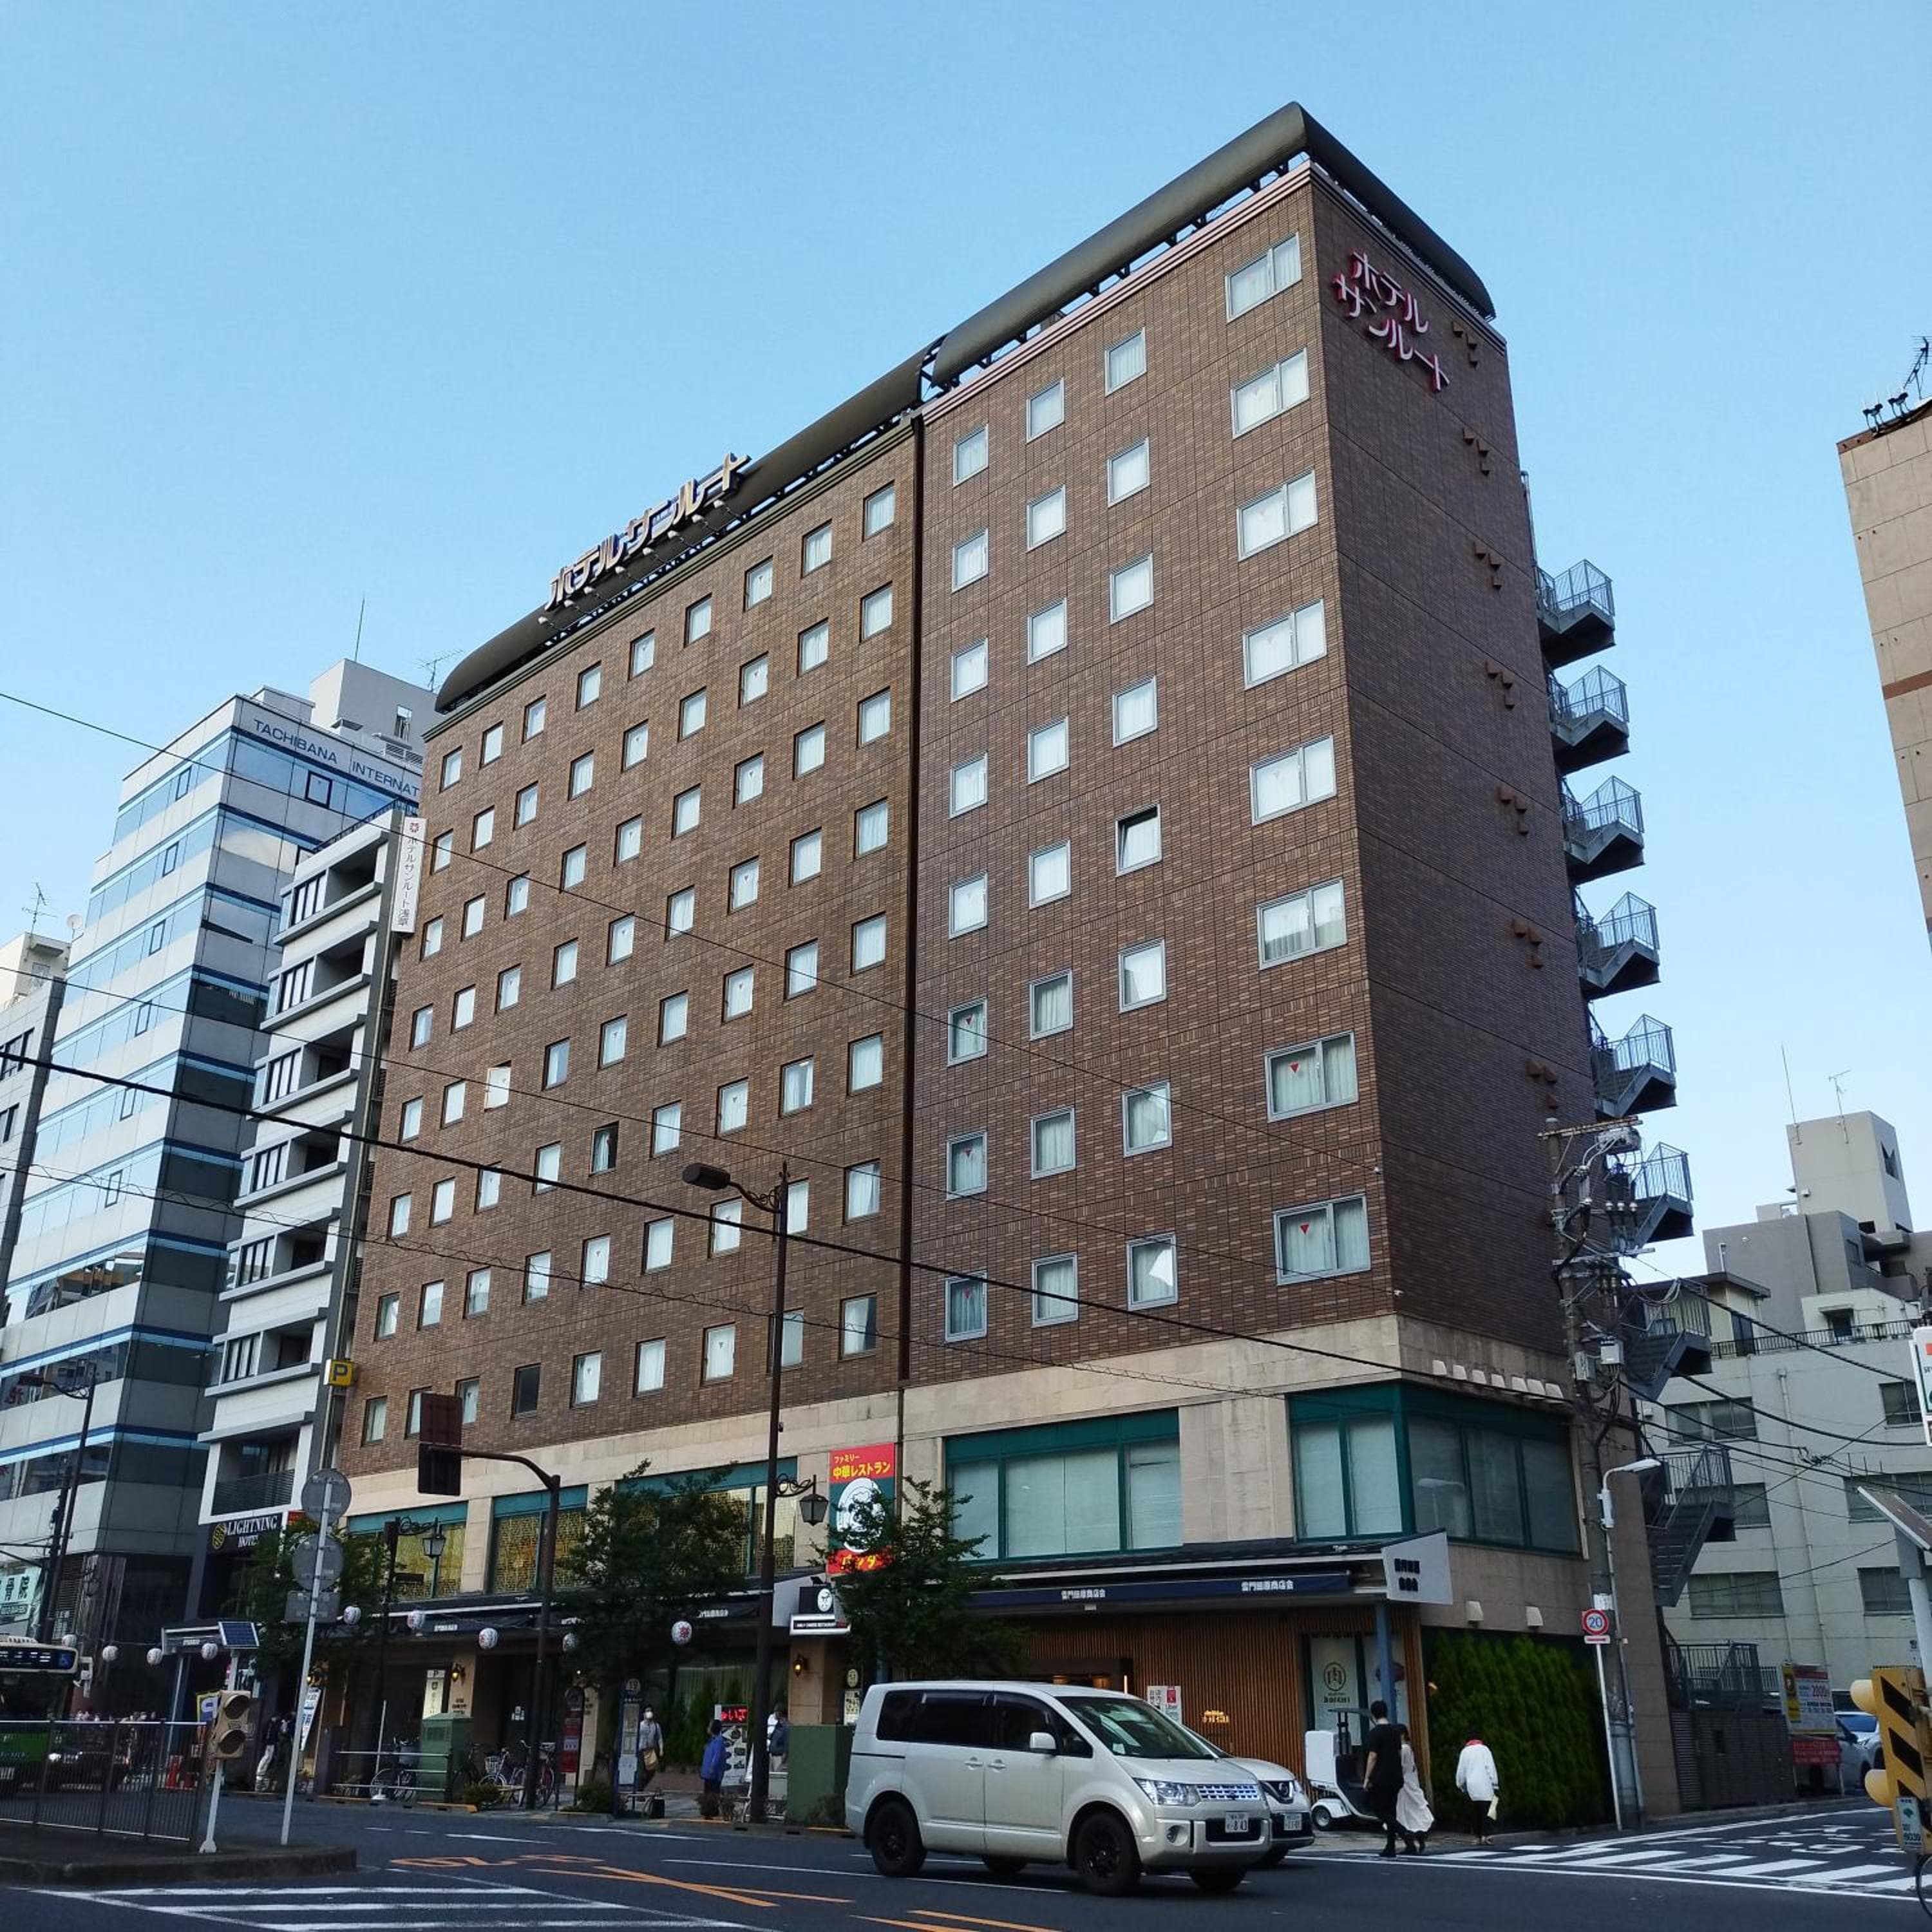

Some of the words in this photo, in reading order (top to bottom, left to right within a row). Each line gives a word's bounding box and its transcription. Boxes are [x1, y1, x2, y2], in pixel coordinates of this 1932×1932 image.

[1351, 250, 1429, 334] ホテル
[1332, 272, 1450, 392] サンルート
[254, 719, 337, 764] TACHIBANA
[333, 1364, 348, 1381] P
[834, 1454, 860, 1464] ファミリー
[833, 1461, 891, 1479] 中華レストラン
[227, 1515, 278, 1536] LIGHTNING
[238, 1535, 259, 1548] HOTE
[1588, 1616, 1603, 1629] 20
